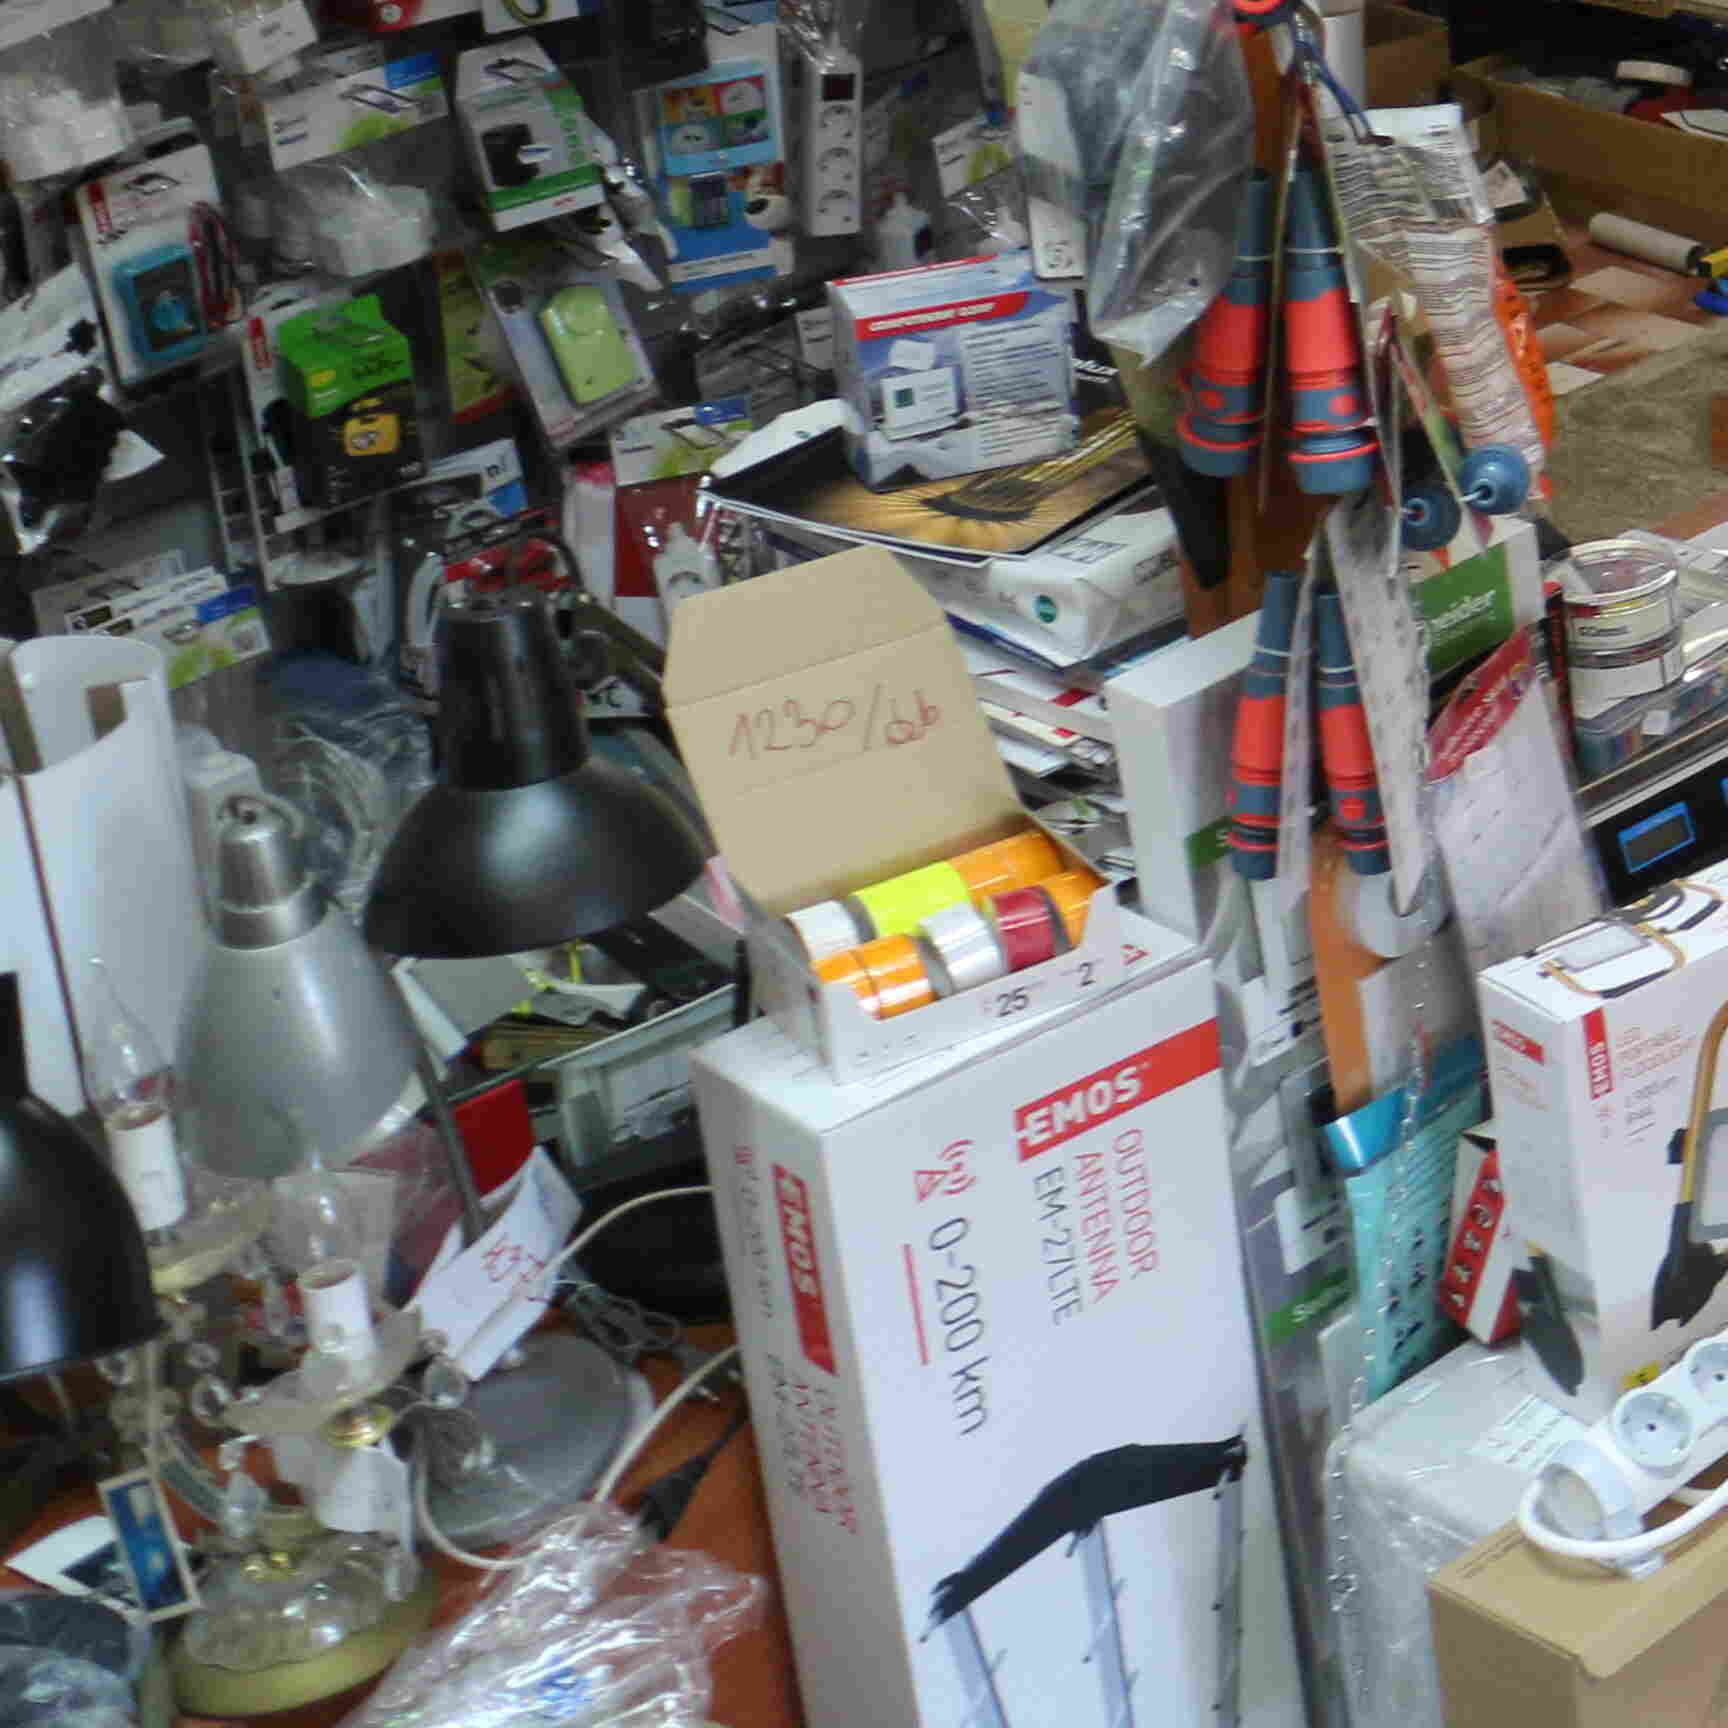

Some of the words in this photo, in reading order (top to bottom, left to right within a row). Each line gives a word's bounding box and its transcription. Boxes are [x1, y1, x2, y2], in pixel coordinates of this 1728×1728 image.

[1021, 1062, 1144, 1148] EMOS
[777, 1173, 817, 1296] EMOS
[1031, 1167, 1082, 1327] EM-27LTE
[1072, 1151, 1123, 1304] ANTENNA
[1110, 1127, 1162, 1281] OUTDOOR
[927, 1215, 988, 1356] 0-200
[946, 1364, 990, 1439] km
